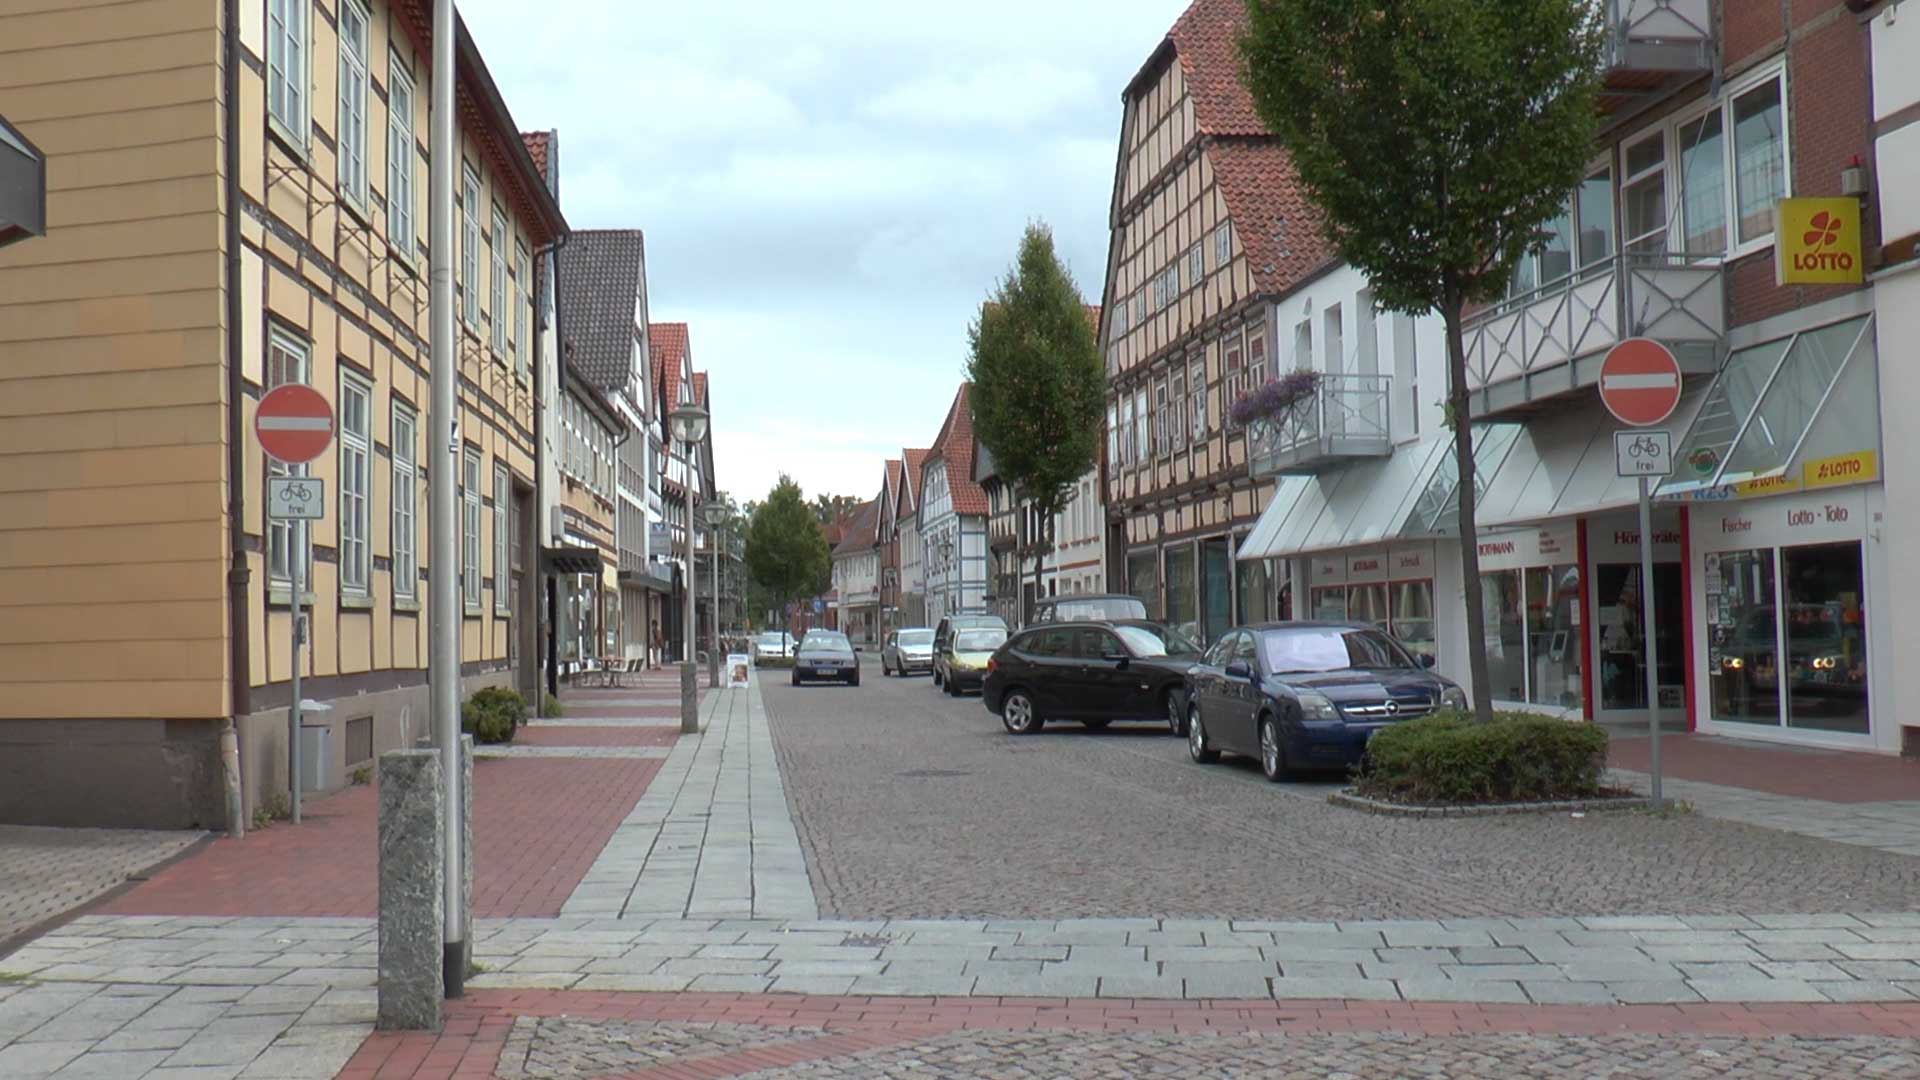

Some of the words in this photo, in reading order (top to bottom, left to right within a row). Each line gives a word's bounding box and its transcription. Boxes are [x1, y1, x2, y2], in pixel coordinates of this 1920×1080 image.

[1793, 253, 1853, 271] LOTTO
[1636, 460, 1655, 471] frei
[1830, 459, 1861, 476] LOTTO
[288, 504, 305, 515] frei
[1787, 509, 1814, 527] Lotto
[1824, 504, 1849, 522] Toto
[1722, 517, 1752, 533] Fischer
[1614, 530, 1681, 545] Hörräte
